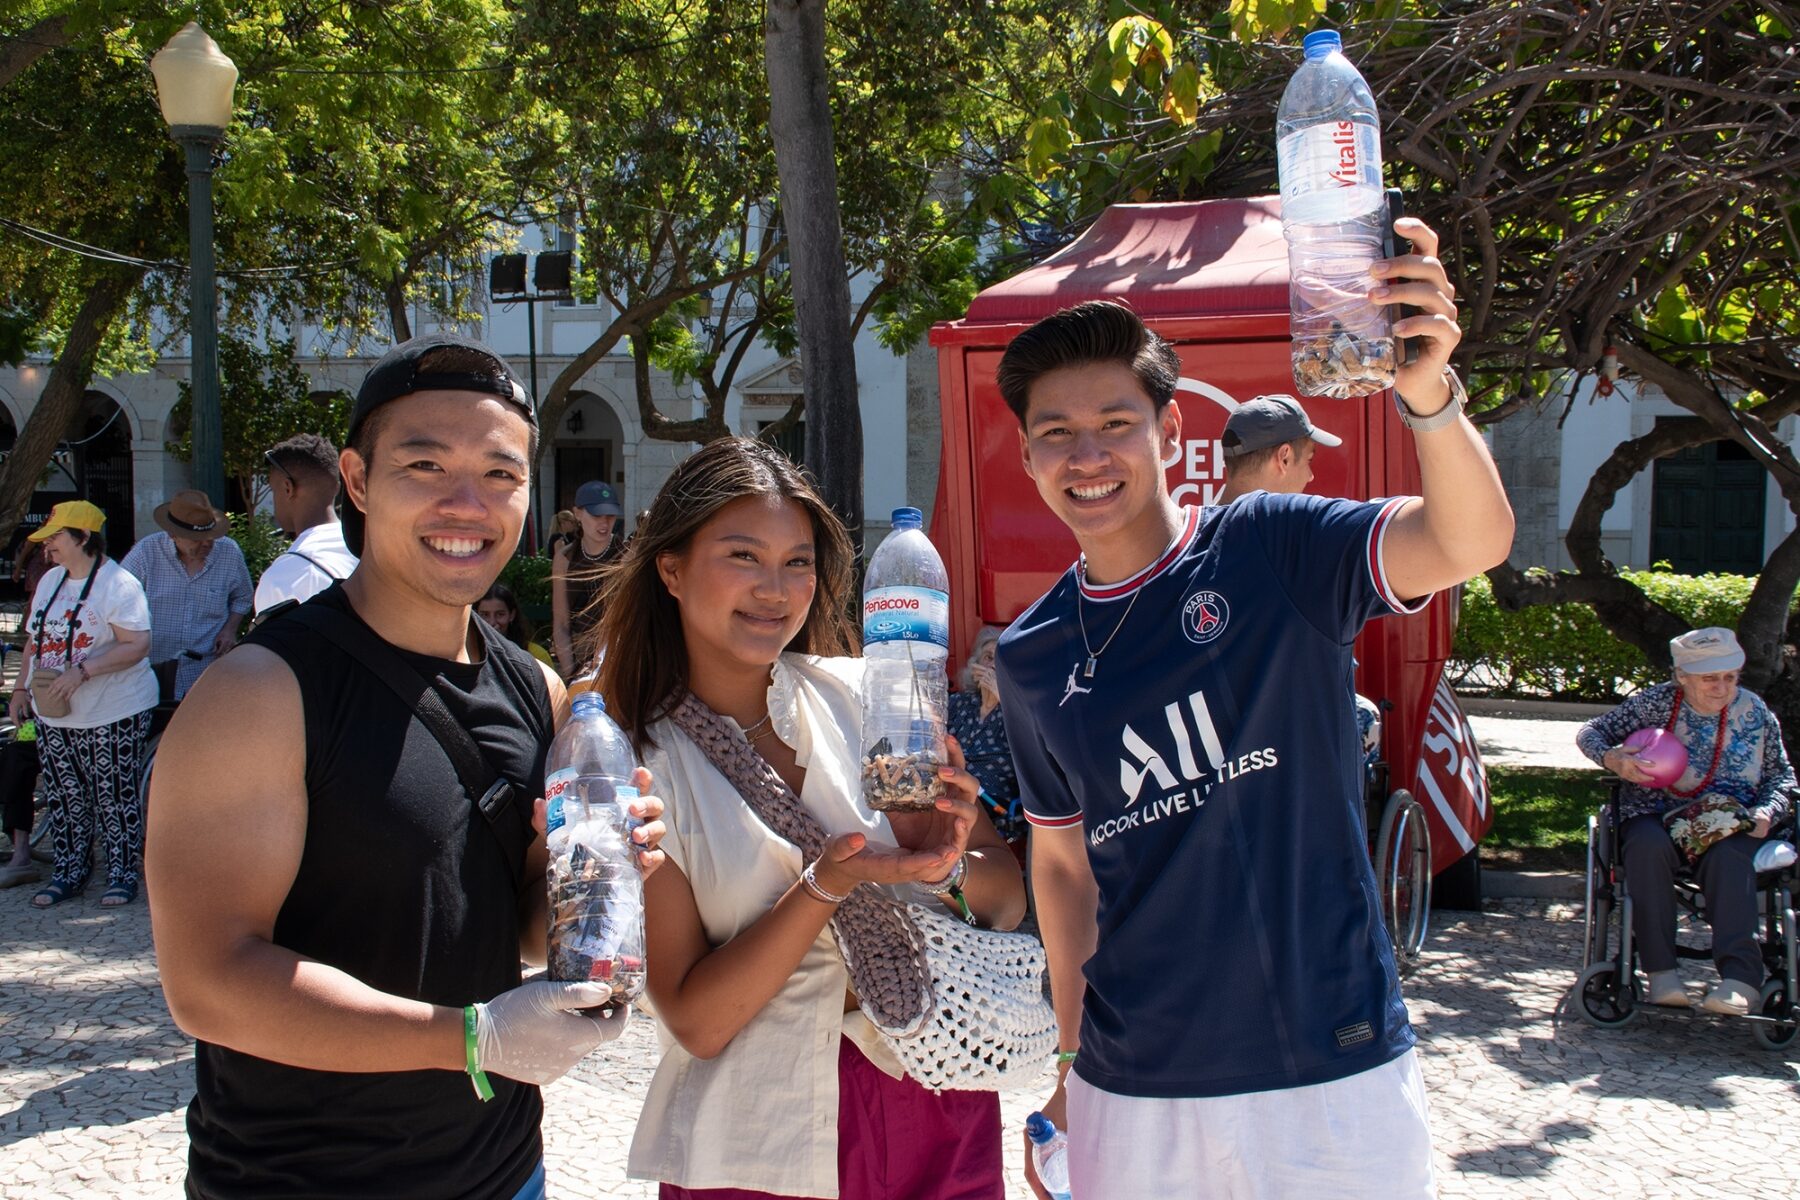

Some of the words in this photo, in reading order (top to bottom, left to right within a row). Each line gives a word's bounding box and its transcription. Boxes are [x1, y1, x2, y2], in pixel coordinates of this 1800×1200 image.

[1329, 121, 1357, 188] Vitalis
[1185, 593, 1215, 614] PARIS
[1090, 811, 1140, 847] ACCOR
[1143, 792, 1190, 824] LIVE
